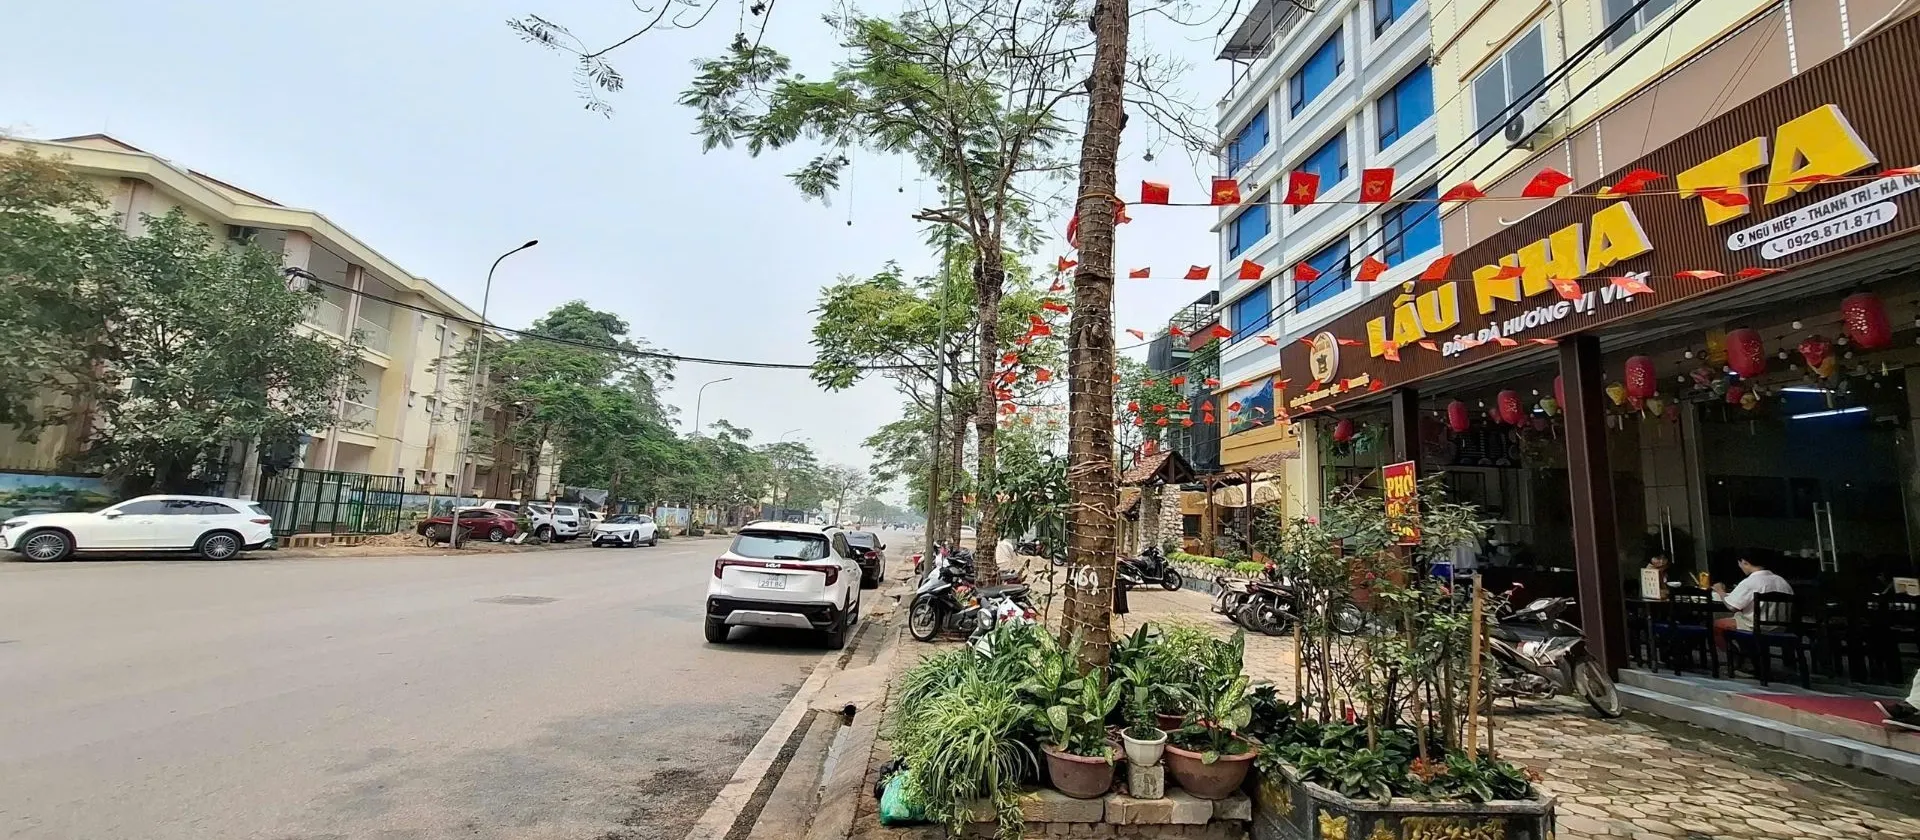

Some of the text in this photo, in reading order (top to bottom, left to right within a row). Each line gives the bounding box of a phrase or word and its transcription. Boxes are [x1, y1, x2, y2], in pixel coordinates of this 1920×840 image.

[1807, 197, 1849, 221] THANH
[1366, 281, 1460, 358] LẨU
[1676, 104, 1880, 226] TA
[1787, 208, 1881, 249] 0929.871.871
[1503, 301, 1571, 337] HƯƠNG
